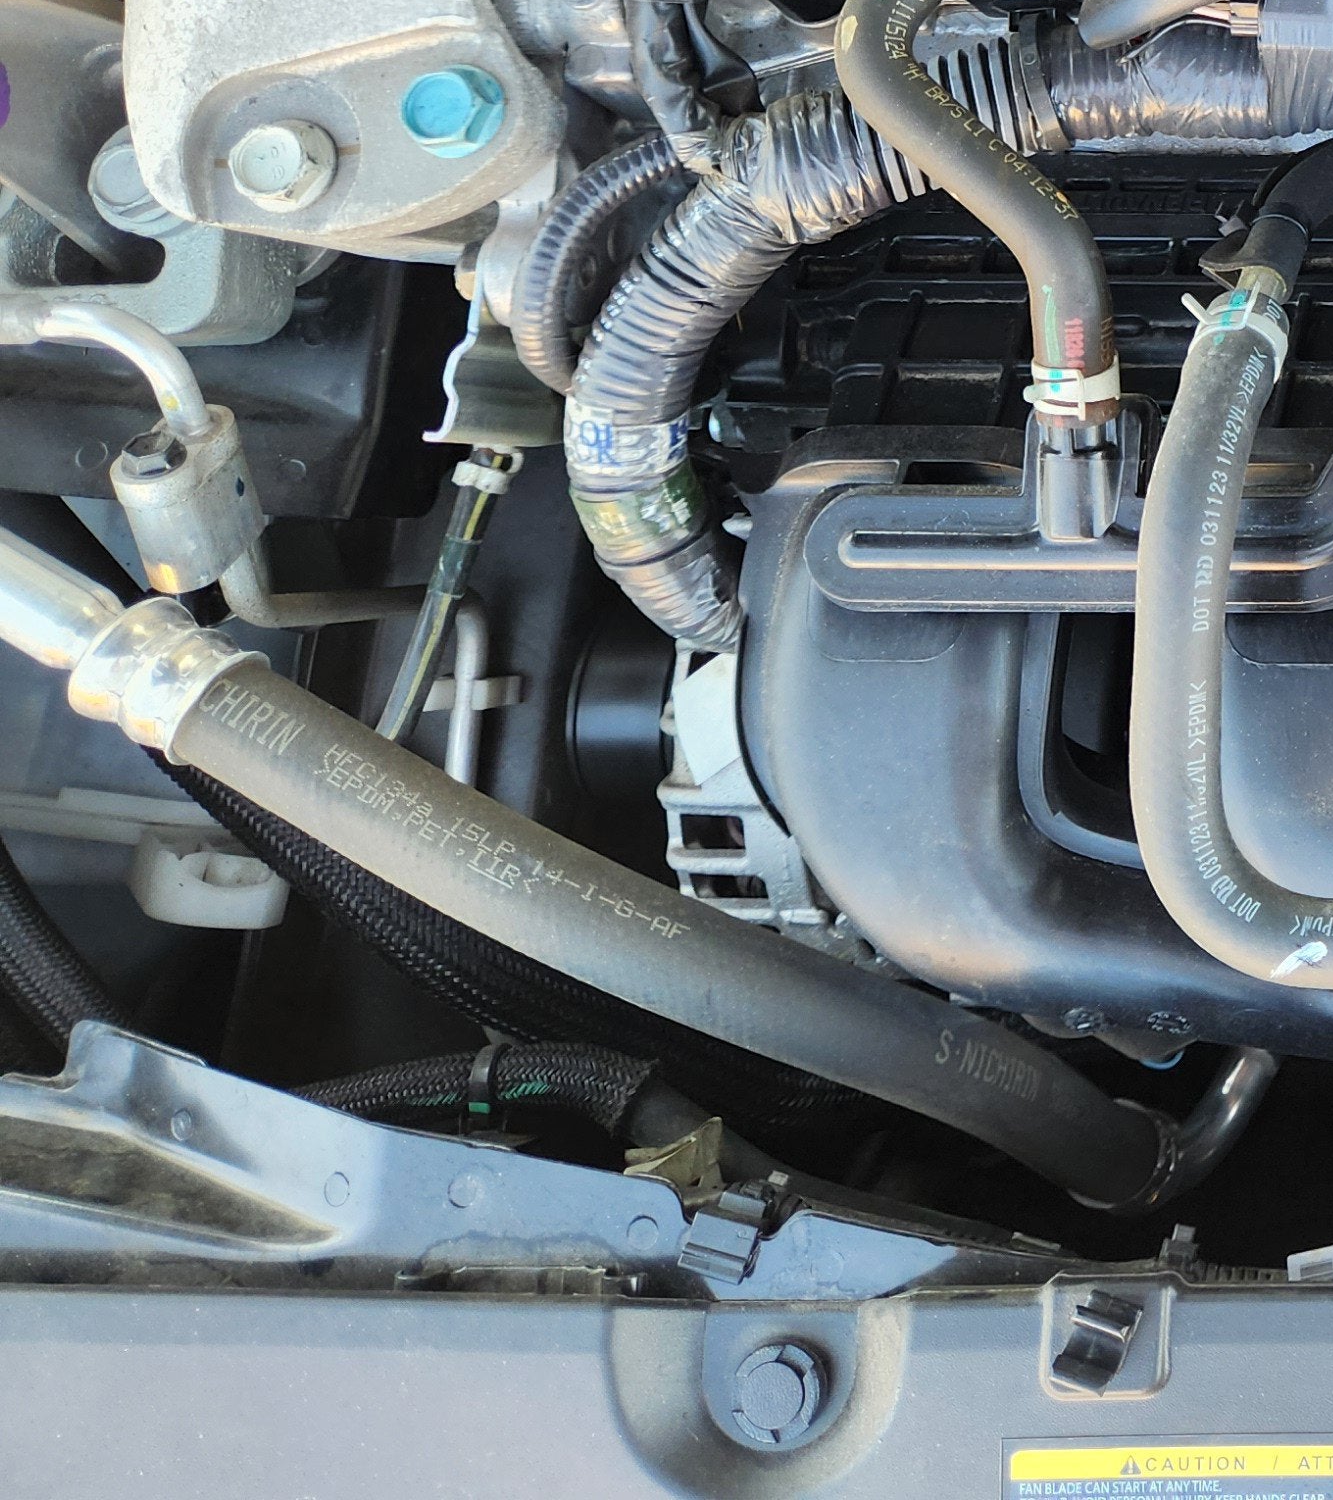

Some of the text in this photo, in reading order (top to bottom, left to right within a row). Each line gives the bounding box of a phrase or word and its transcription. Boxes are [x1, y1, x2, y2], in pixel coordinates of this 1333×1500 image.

[1235, 345, 1269, 405] >EPDM<
[1200, 468, 1230, 547] 031123
[1191, 595, 1212, 635] DOT
[1186, 679, 1207, 751] >EPDM<
[326, 743, 434, 817] HFC134a
[449, 816, 517, 858] 15LP
[1227, 891, 1263, 925] DOT
[1019, 1481, 1043, 1496] FAN
[1044, 1480, 1083, 1495] BLADE
[1084, 1480, 1111, 1495] CAN
[1112, 1480, 1148, 1494] START
[1149, 1479, 1165, 1493] AT
[1144, 1455, 1247, 1472] CAUTION
